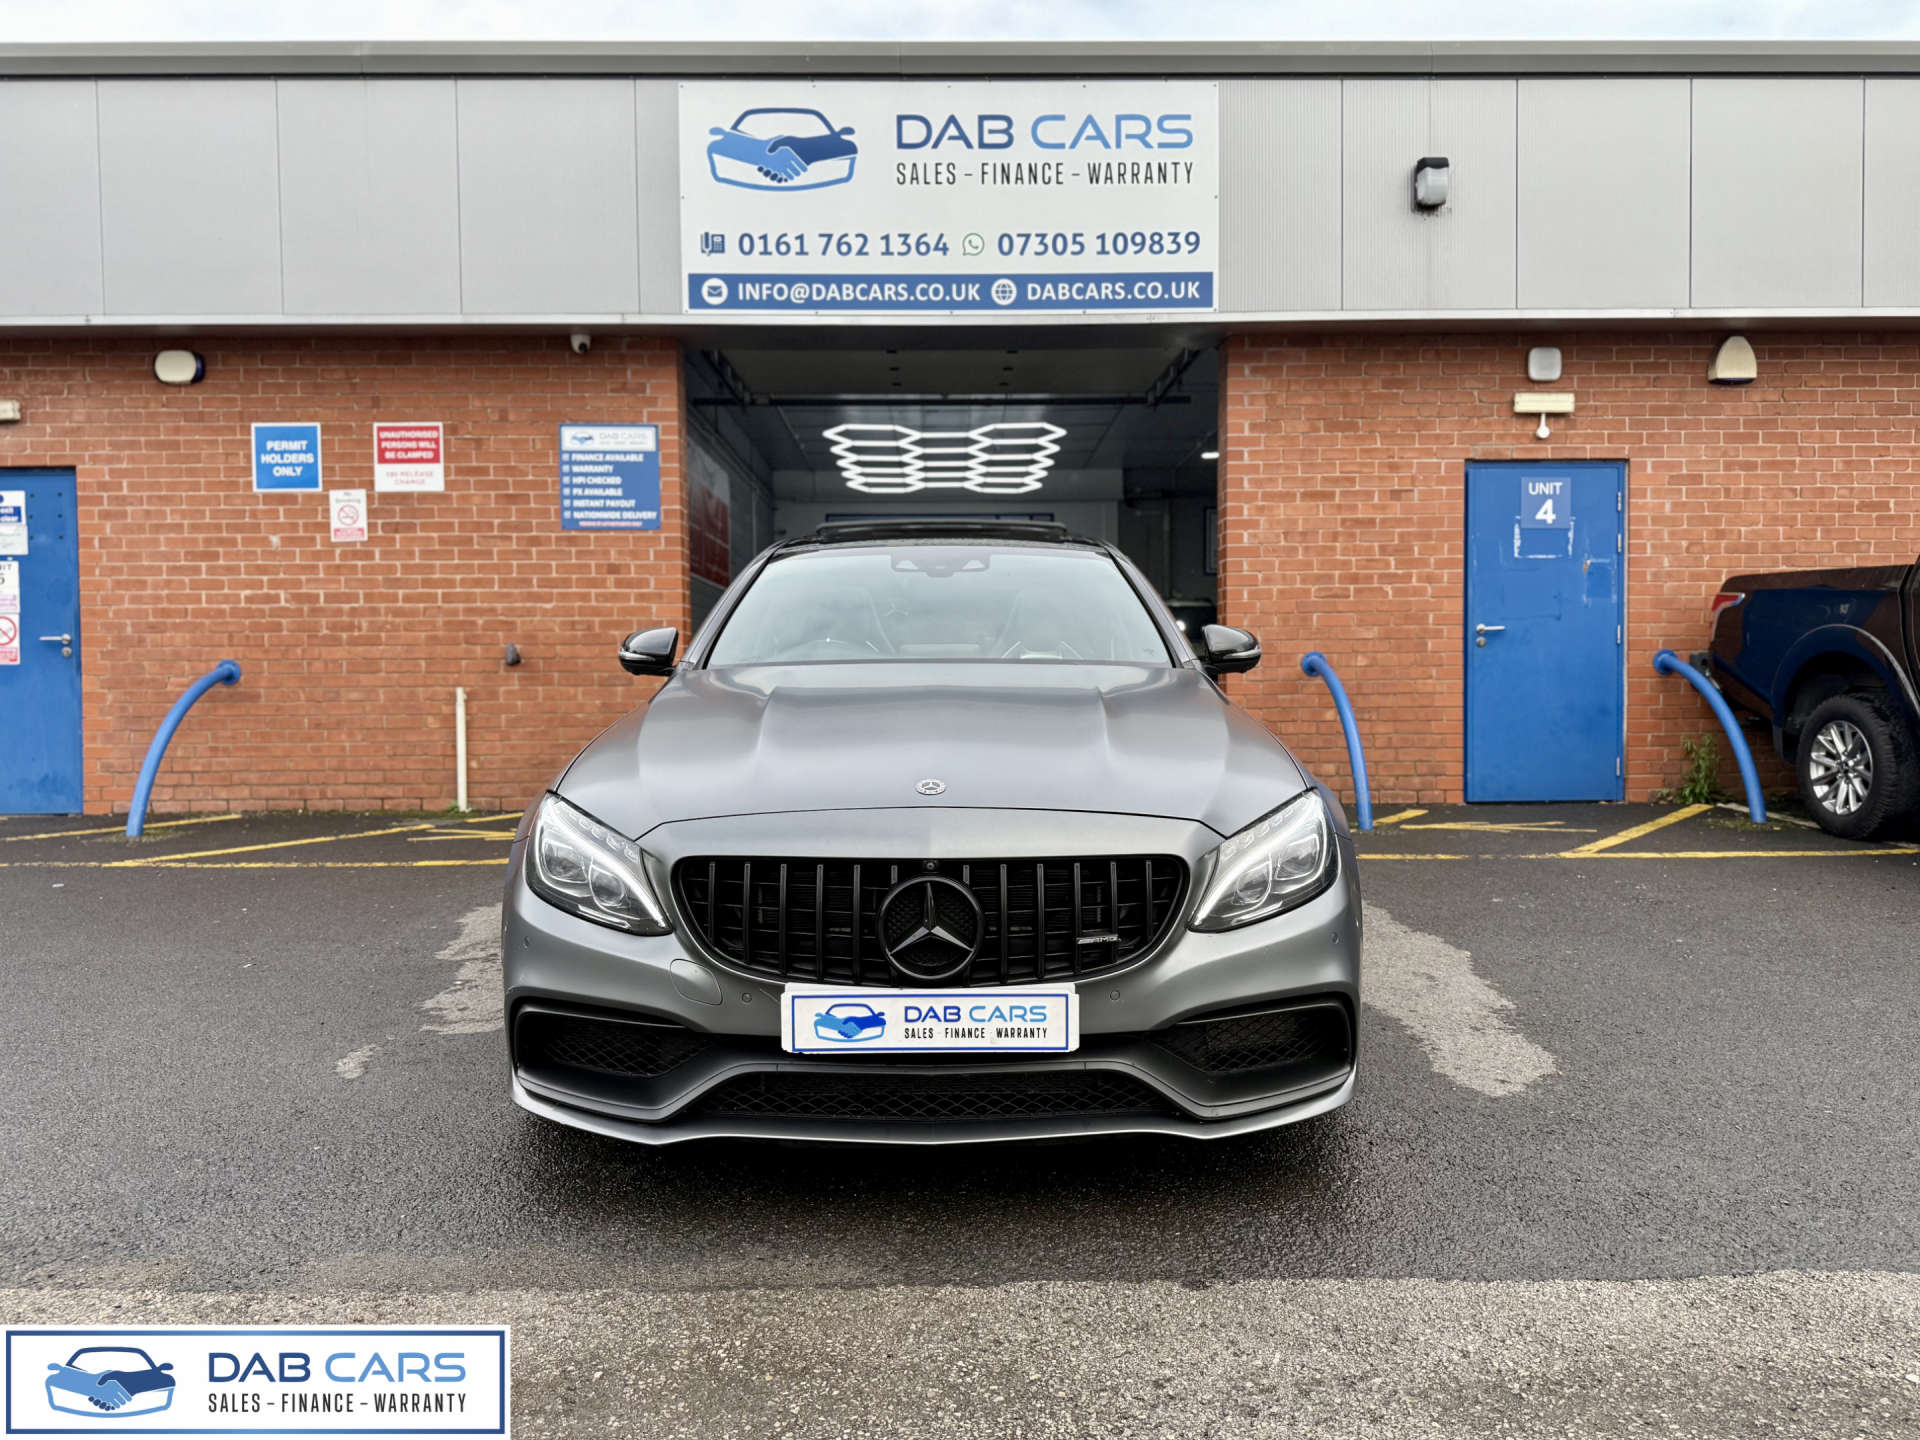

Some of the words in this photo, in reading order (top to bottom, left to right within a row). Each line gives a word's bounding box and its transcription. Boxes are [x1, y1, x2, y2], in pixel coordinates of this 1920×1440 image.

[896, 114, 1014, 150] DAB
[1032, 114, 1193, 149] CARS
[896, 163, 956, 185] SALES
[981, 163, 1064, 185] FINANCE
[1087, 162, 1193, 185] WARRANTY
[738, 232, 809, 256] 0161
[819, 232, 870, 256] 762
[880, 232, 950, 256] 1364
[998, 232, 1086, 256] 07305
[1096, 231, 1201, 256] 109839
[738, 282, 981, 304] INFO@DABCARS.CO.UK
[1027, 281, 1201, 301] DABCARS.CO.UK
[266, 440, 308, 451] PERMIT
[381, 440, 417, 449] PERSONS
[418, 440, 436, 449] WILL
[261, 453, 314, 465] HOLDERS
[385, 451, 396, 459] BE
[397, 450, 434, 459] CLAMPED
[572, 453, 604, 462] FINANCE
[604, 453, 644, 462] AVAILABLE
[273, 466, 303, 477] ONLY
[572, 464, 614, 473] WARRANTY
[587, 476, 622, 485] CHECKED
[584, 488, 622, 496] AVAILABLE
[1528, 482, 1563, 495] UNIT
[573, 499, 604, 508] INSTANT
[606, 499, 637, 508] PAYOUT
[573, 511, 621, 519] NATIONWIDE
[623, 511, 657, 520] DELIVERY
[1535, 498, 1556, 525] 4
[904, 1005, 961, 1023] DAB
[969, 1005, 1047, 1023] CARS
[904, 1028, 934, 1039] SALES
[945, 1028, 985, 1039] FINANCE
[996, 1028, 1047, 1039] WARRANTY
